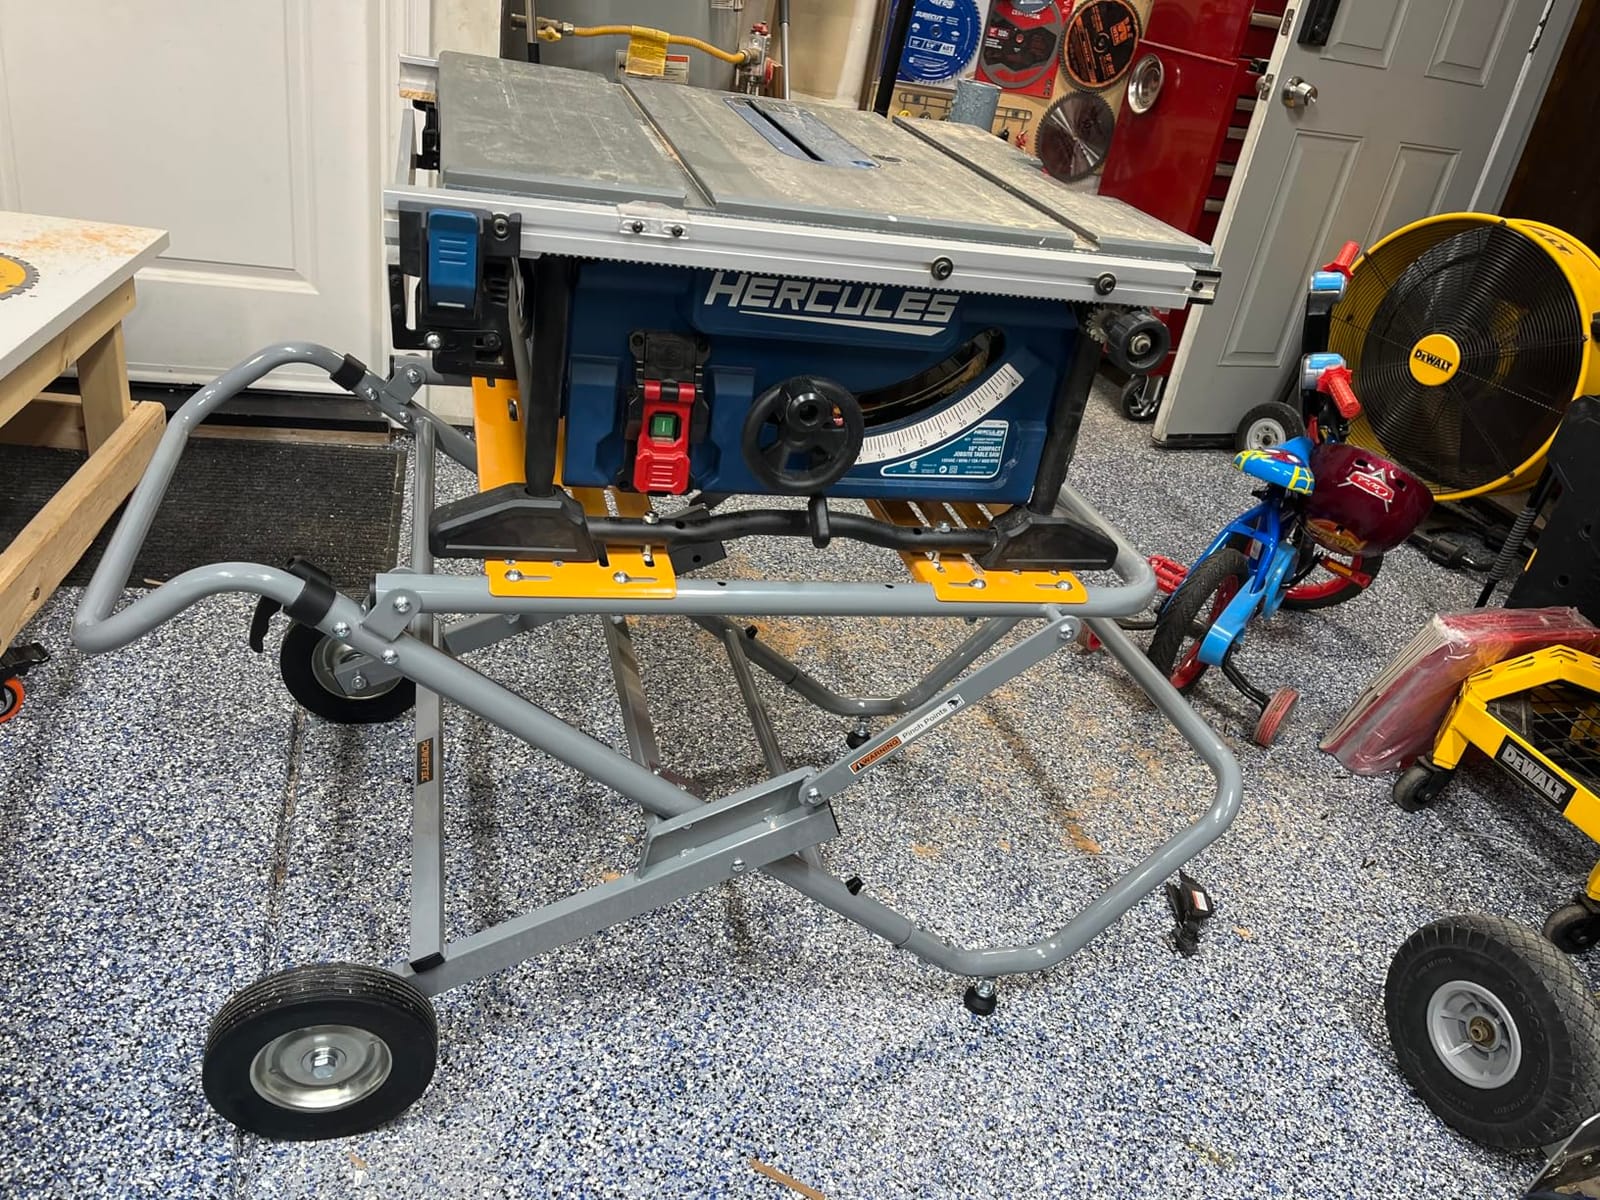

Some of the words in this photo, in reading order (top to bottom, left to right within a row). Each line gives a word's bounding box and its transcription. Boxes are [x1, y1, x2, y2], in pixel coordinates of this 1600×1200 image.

[703, 271, 961, 323] HERCULES
[1010, 379, 1019, 387] 45
[995, 392, 1004, 401] 40
[977, 407, 986, 416] 35
[959, 419, 968, 428] 30
[939, 430, 948, 438] 25
[902, 723, 924, 739] Pinch
[923, 707, 949, 725] Points
[862, 739, 899, 764] WARNING
[420, 740, 430, 782] POWERTEC
